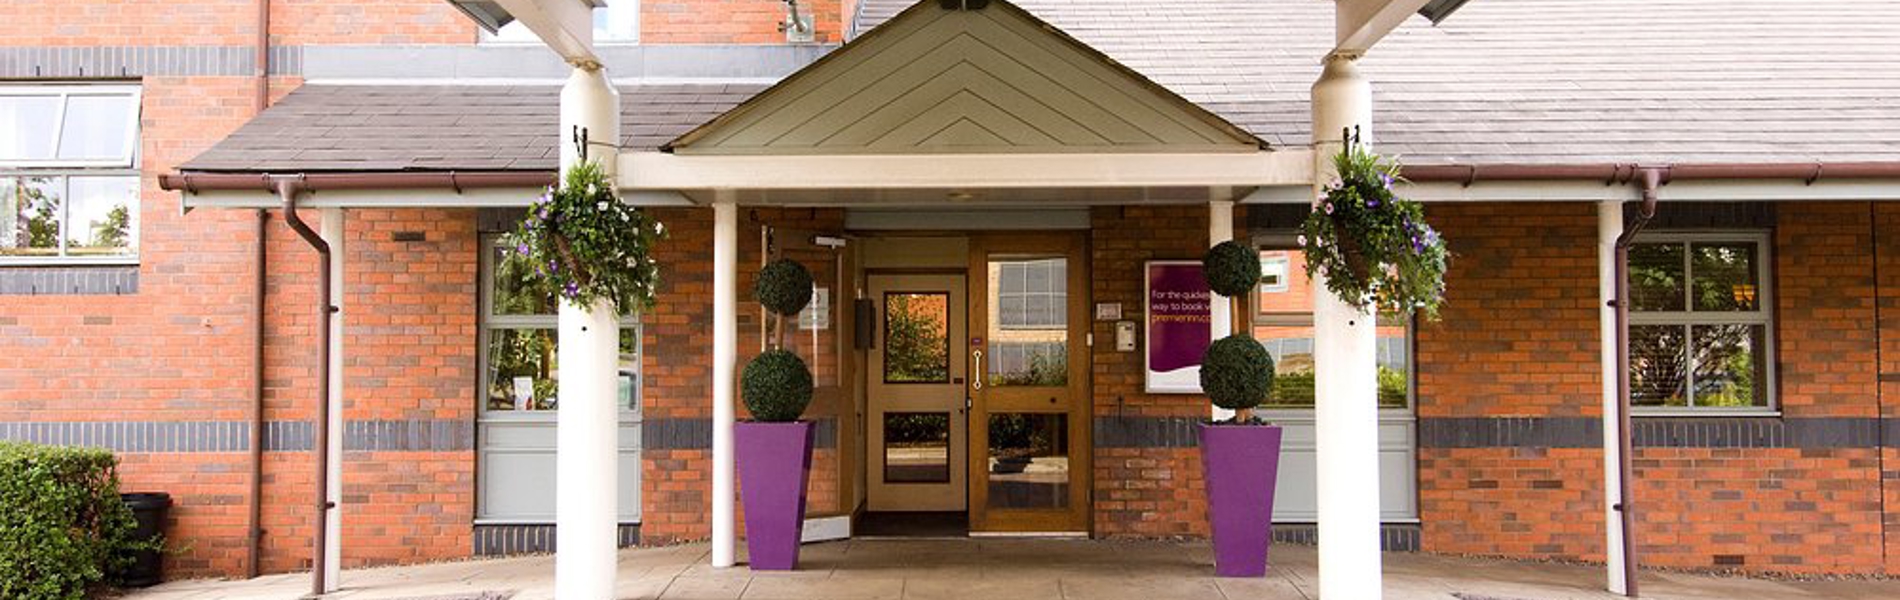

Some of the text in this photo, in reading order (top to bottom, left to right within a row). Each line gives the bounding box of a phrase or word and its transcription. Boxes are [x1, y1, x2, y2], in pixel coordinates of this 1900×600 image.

[1151, 290, 1211, 301] For the quickes
[1151, 303, 1169, 312] way
[1170, 303, 1181, 311] to
[1181, 301, 1203, 311] book
[1151, 314, 1211, 325] premierinn.co
